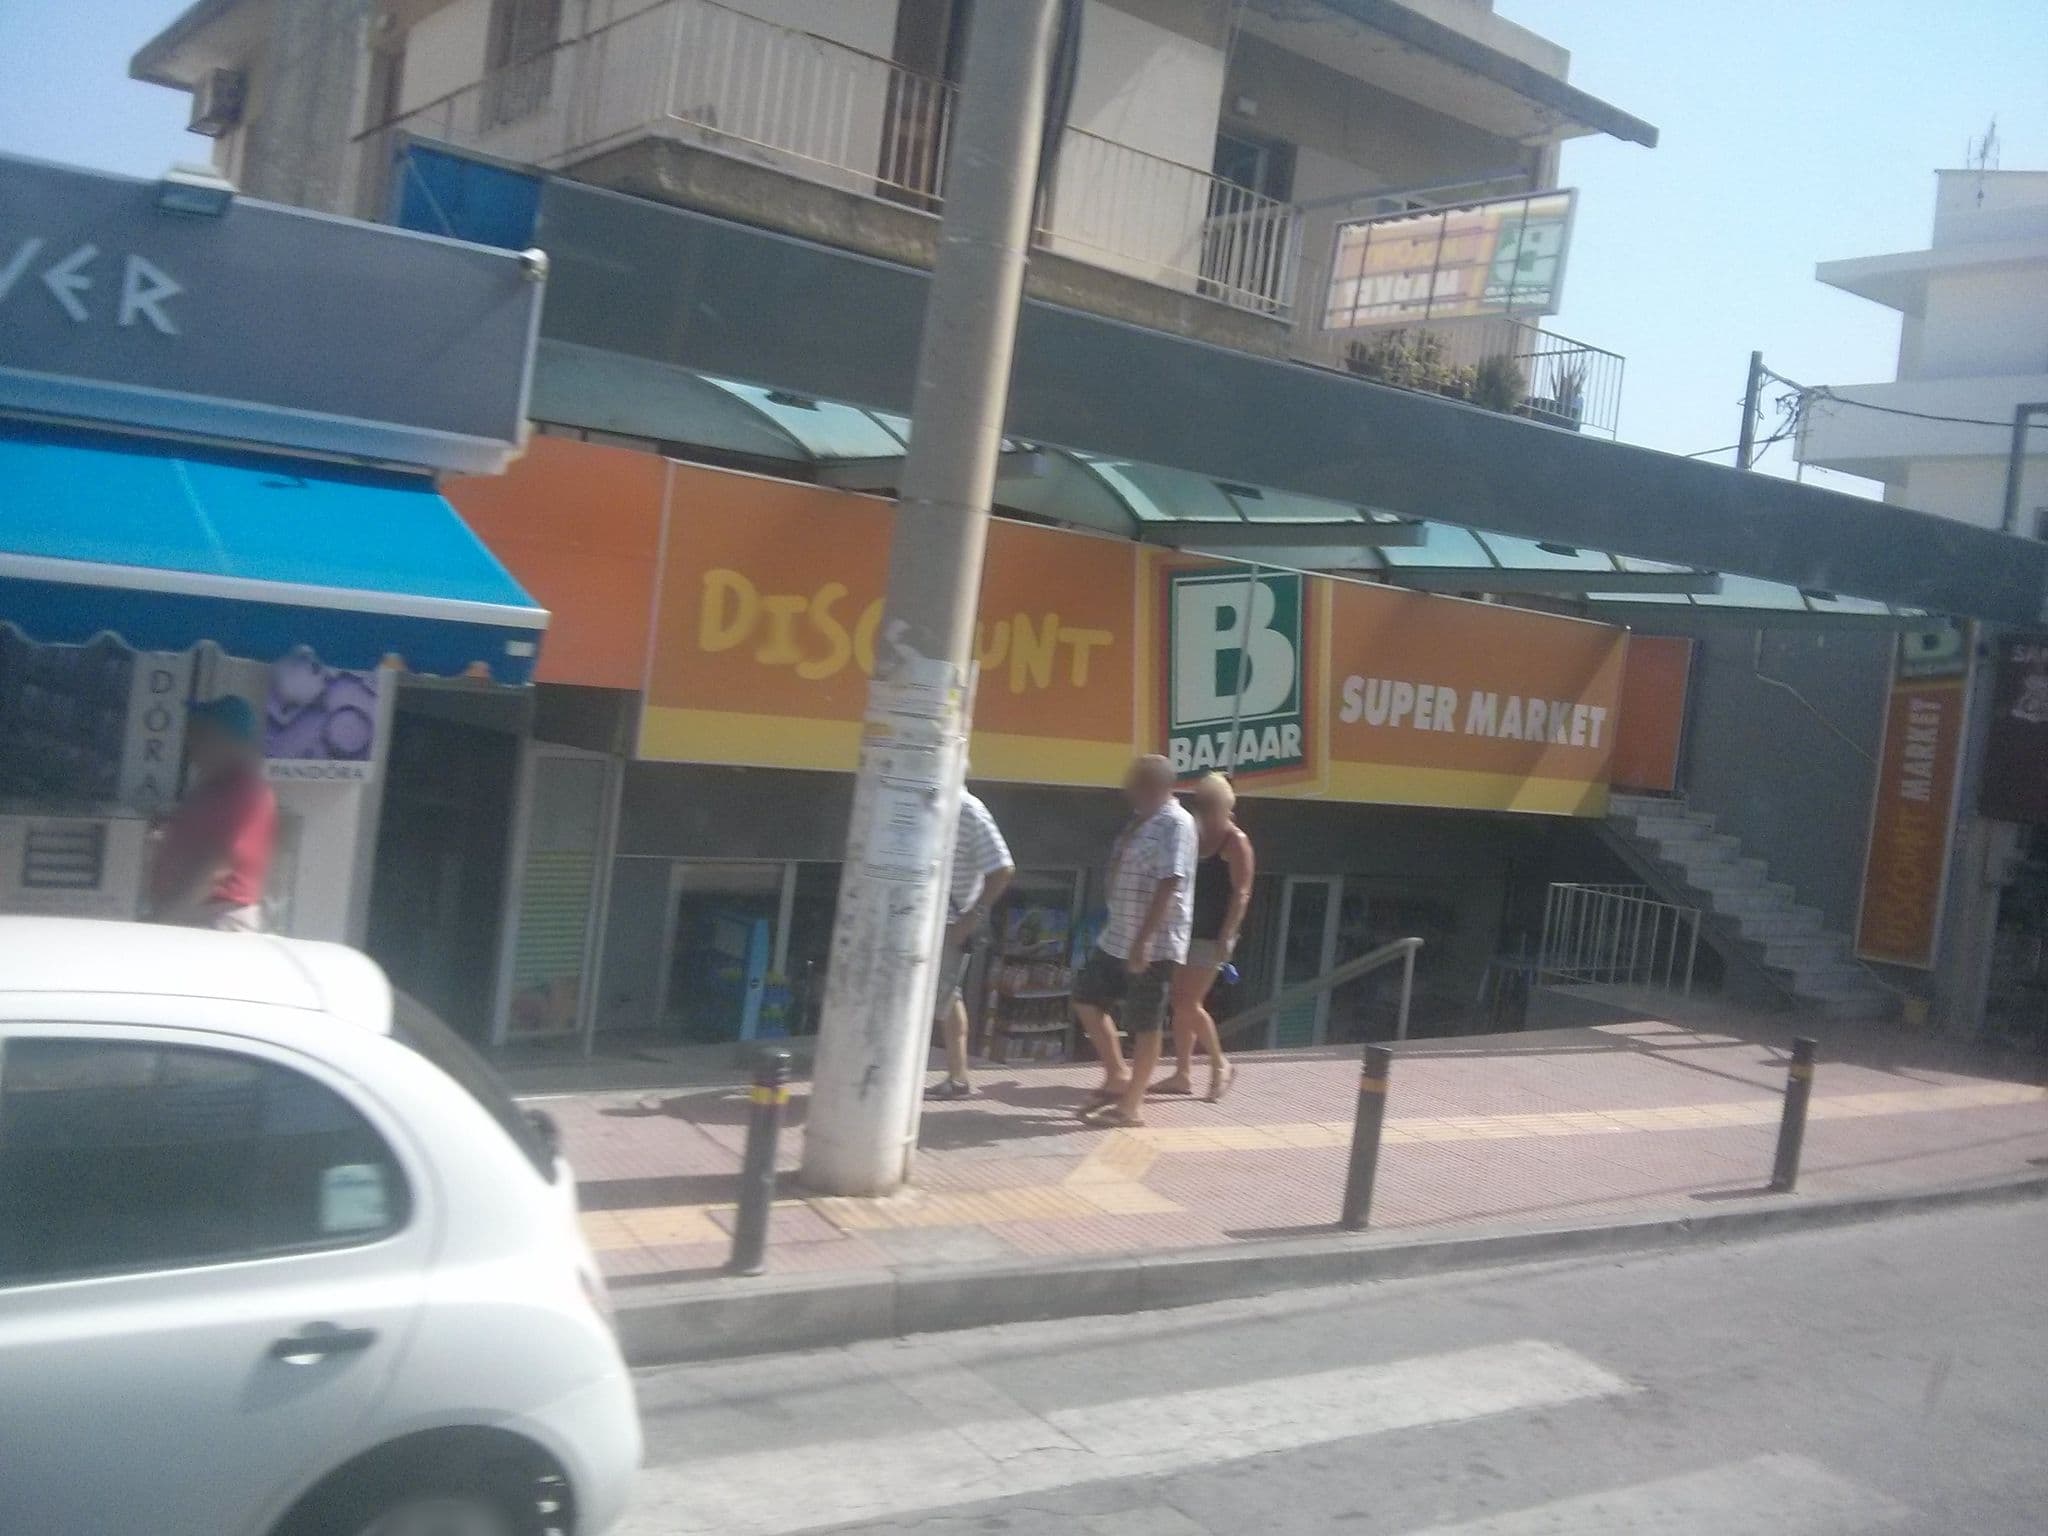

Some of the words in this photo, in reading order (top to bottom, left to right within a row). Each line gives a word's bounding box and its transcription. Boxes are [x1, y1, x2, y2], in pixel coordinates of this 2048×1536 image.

[702, 568, 1113, 694] DISCUNT
[1176, 580, 1296, 724] B
[1169, 723, 1302, 775] BAZAAR
[1339, 673, 1456, 734] SUPER
[1464, 690, 1607, 749] MARKET
